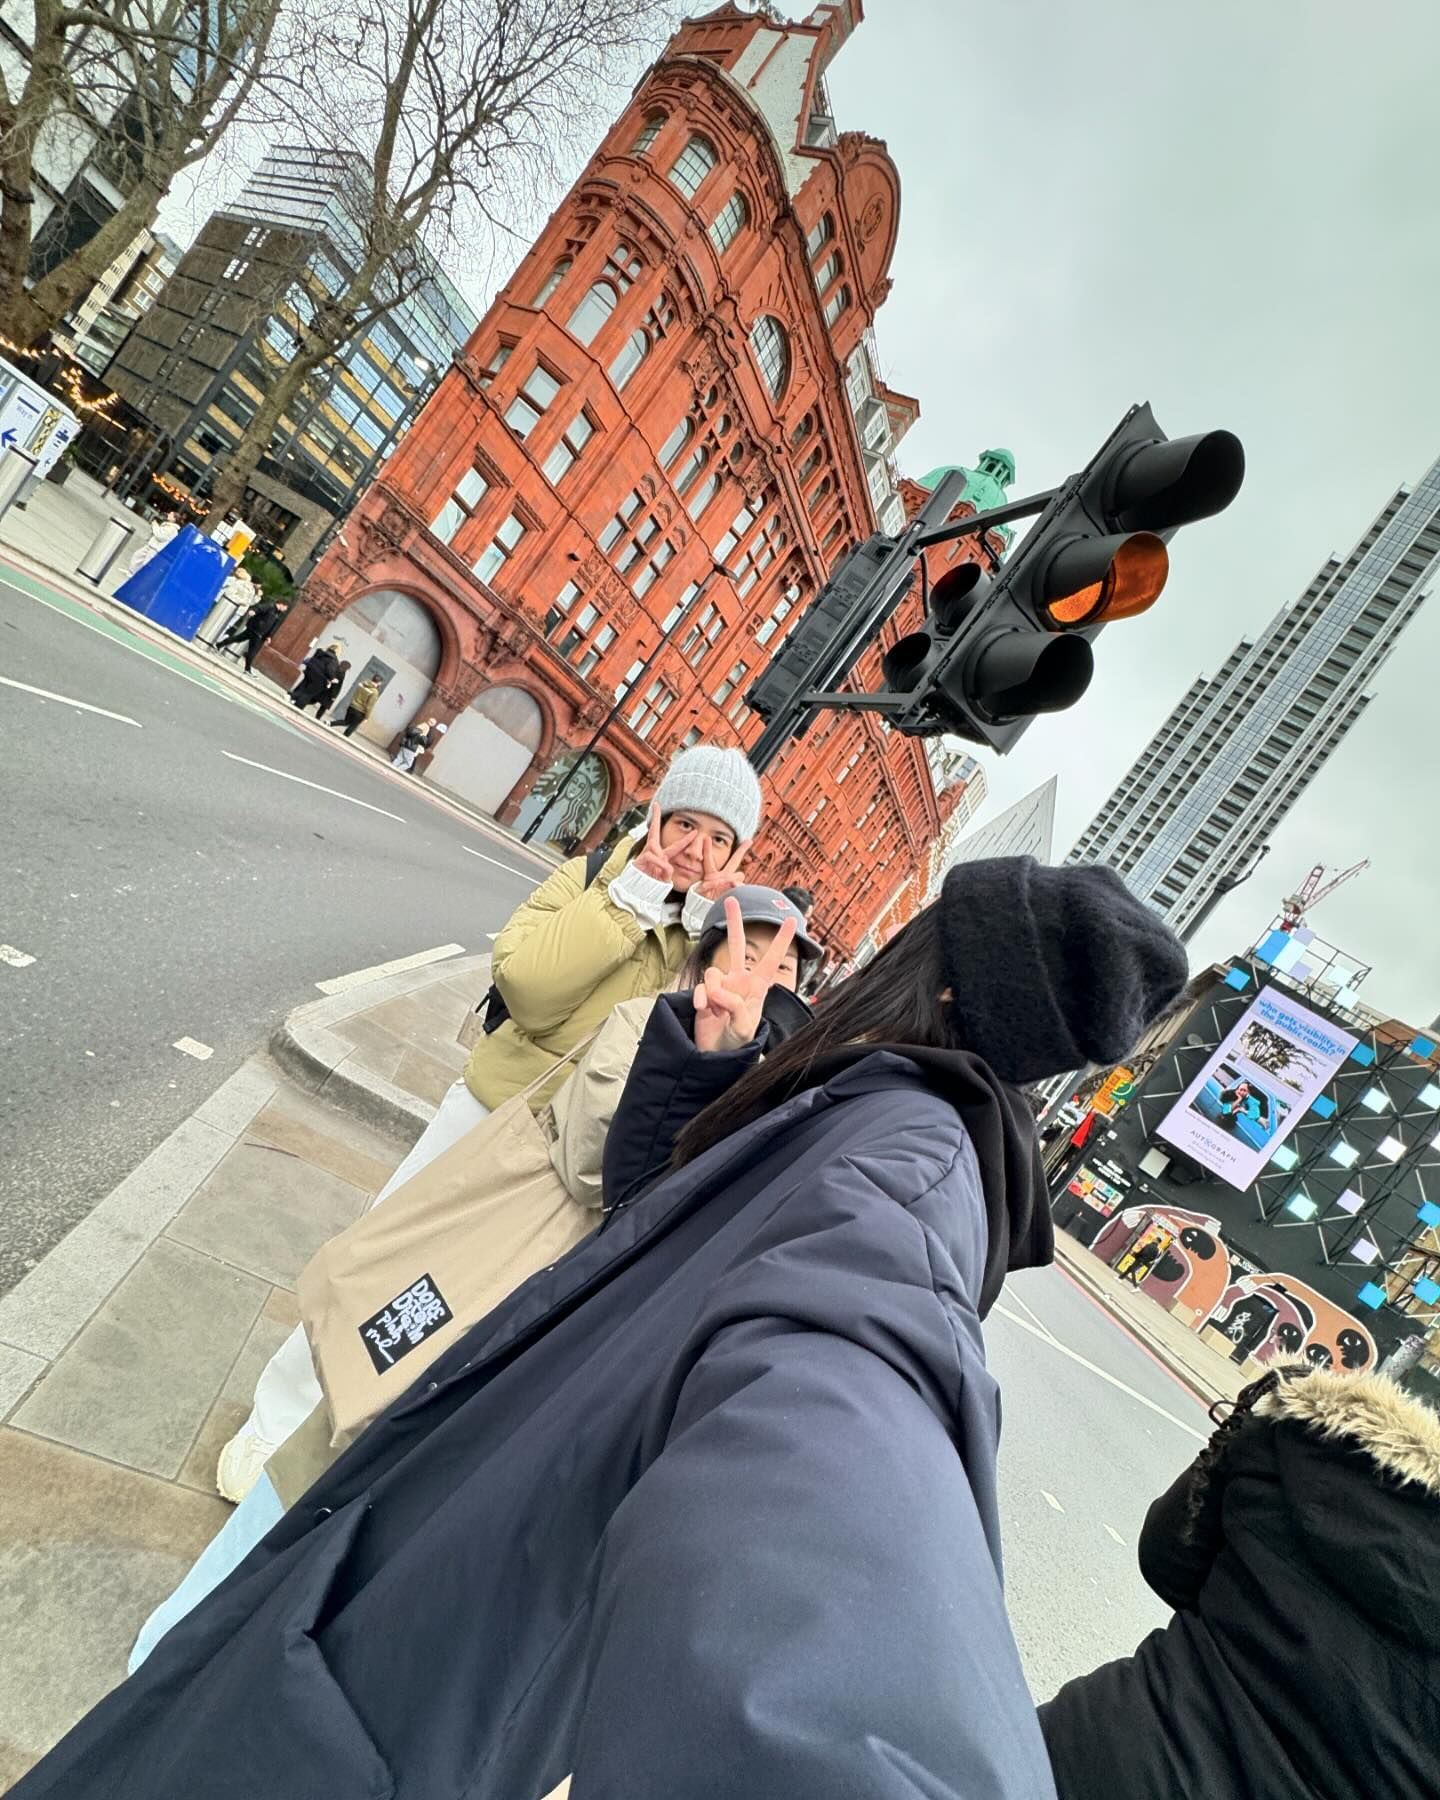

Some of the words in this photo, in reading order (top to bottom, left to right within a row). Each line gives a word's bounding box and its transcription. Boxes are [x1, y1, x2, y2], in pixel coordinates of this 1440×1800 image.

[1275, 1019, 1303, 1037] public
[1278, 1012, 1297, 1026] gets
[1299, 1023, 1336, 1048] visibility
